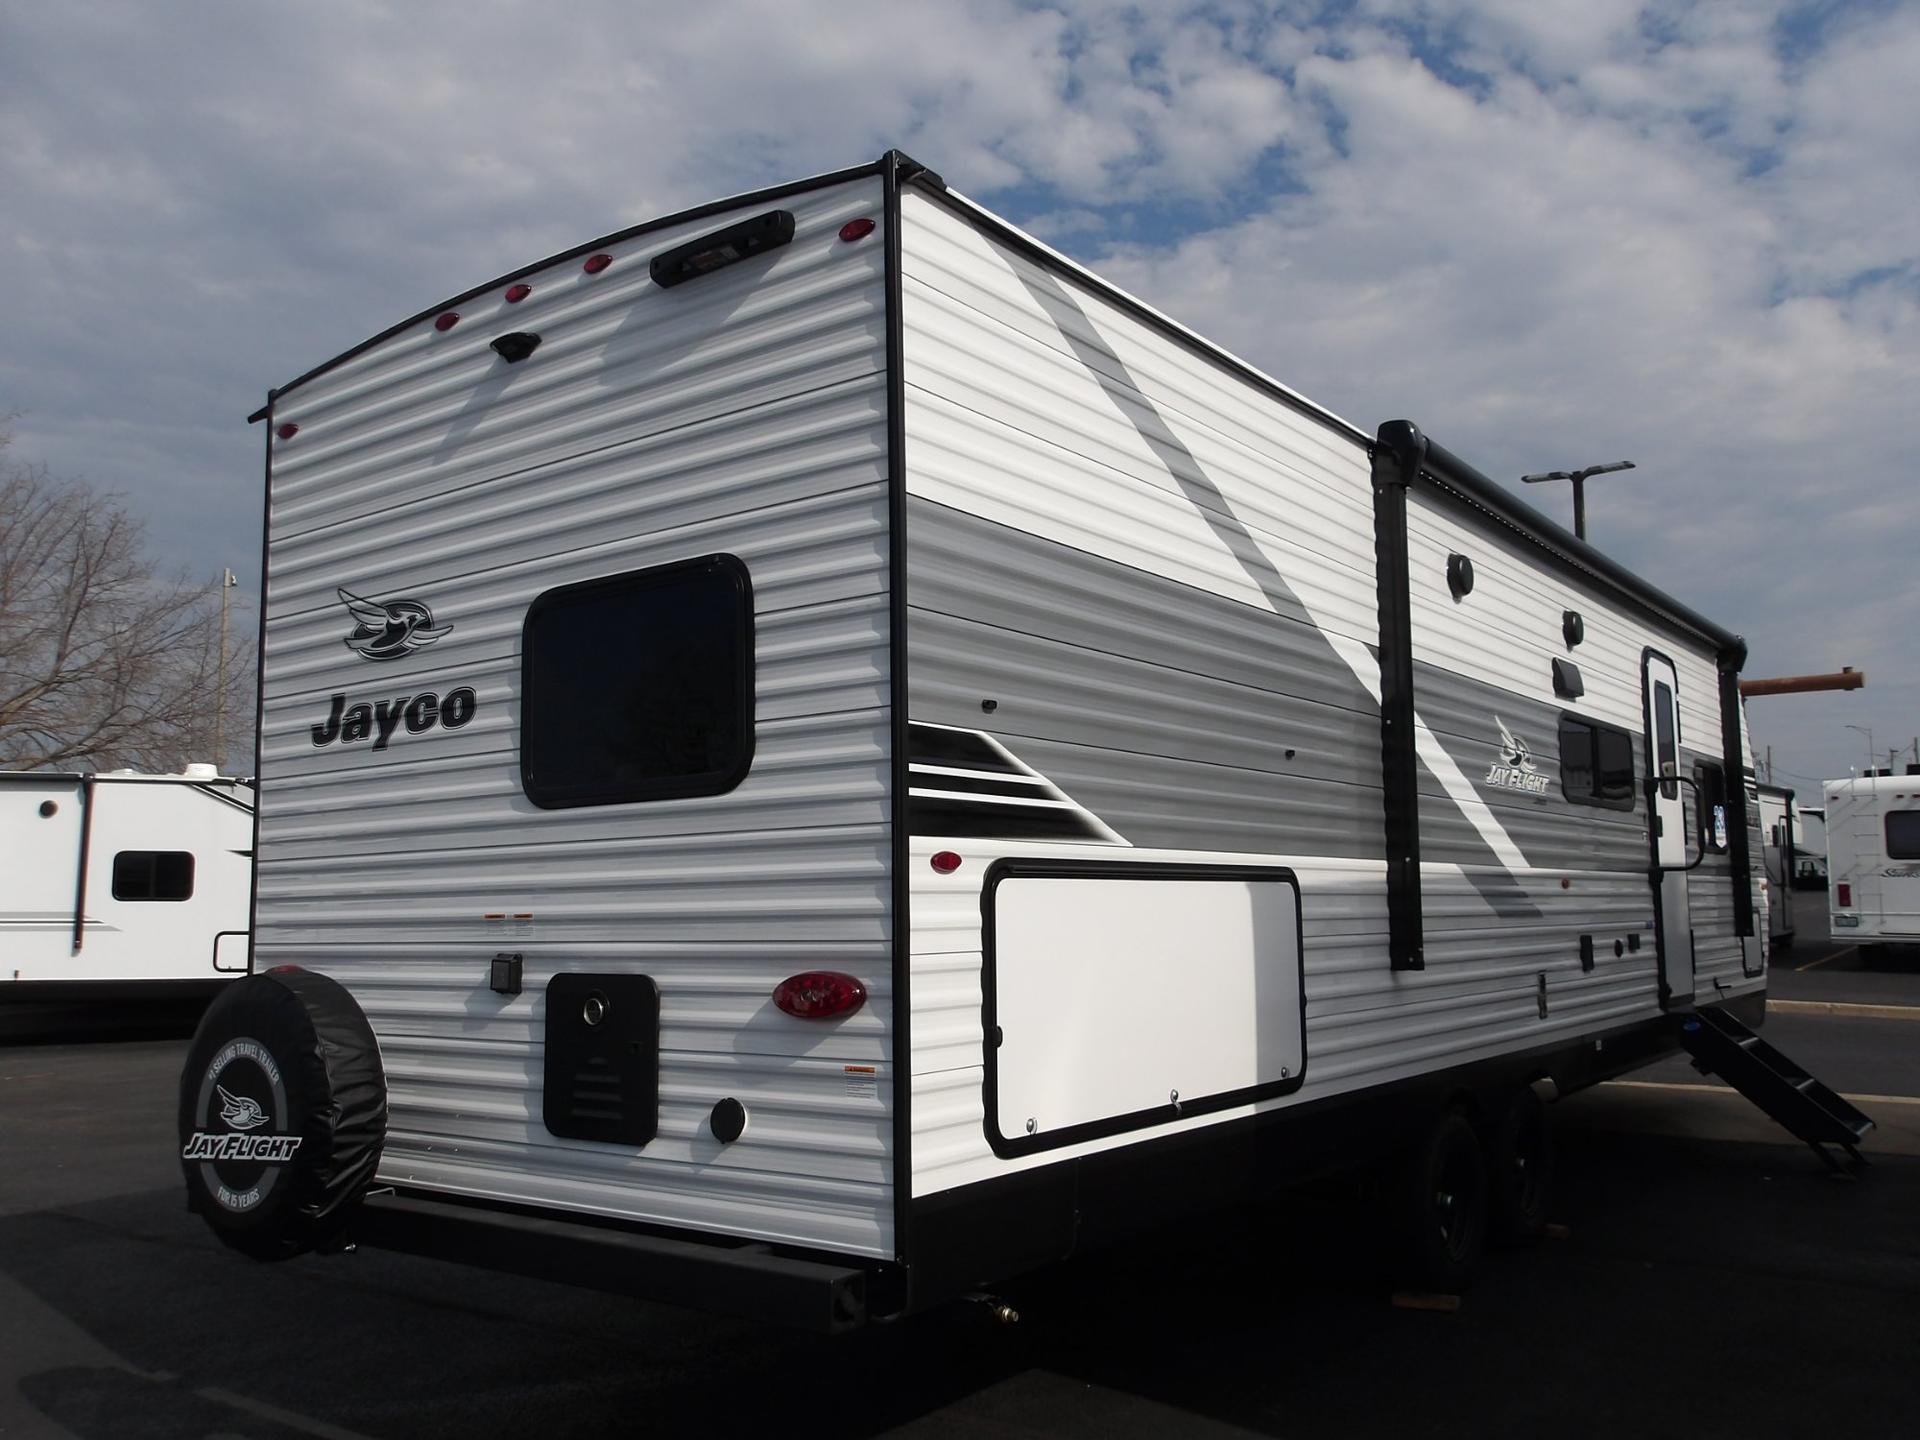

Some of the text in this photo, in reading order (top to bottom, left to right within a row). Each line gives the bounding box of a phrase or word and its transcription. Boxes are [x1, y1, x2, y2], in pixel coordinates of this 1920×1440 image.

[311, 686, 477, 752] Jayco
[1486, 762, 1549, 795] JAY FLIGHT
[213, 1045, 236, 1073] SELLING
[236, 1043, 258, 1059] TRAVEL
[258, 1049, 280, 1086] TRAILER
[238, 1187, 261, 1209] YEARS
